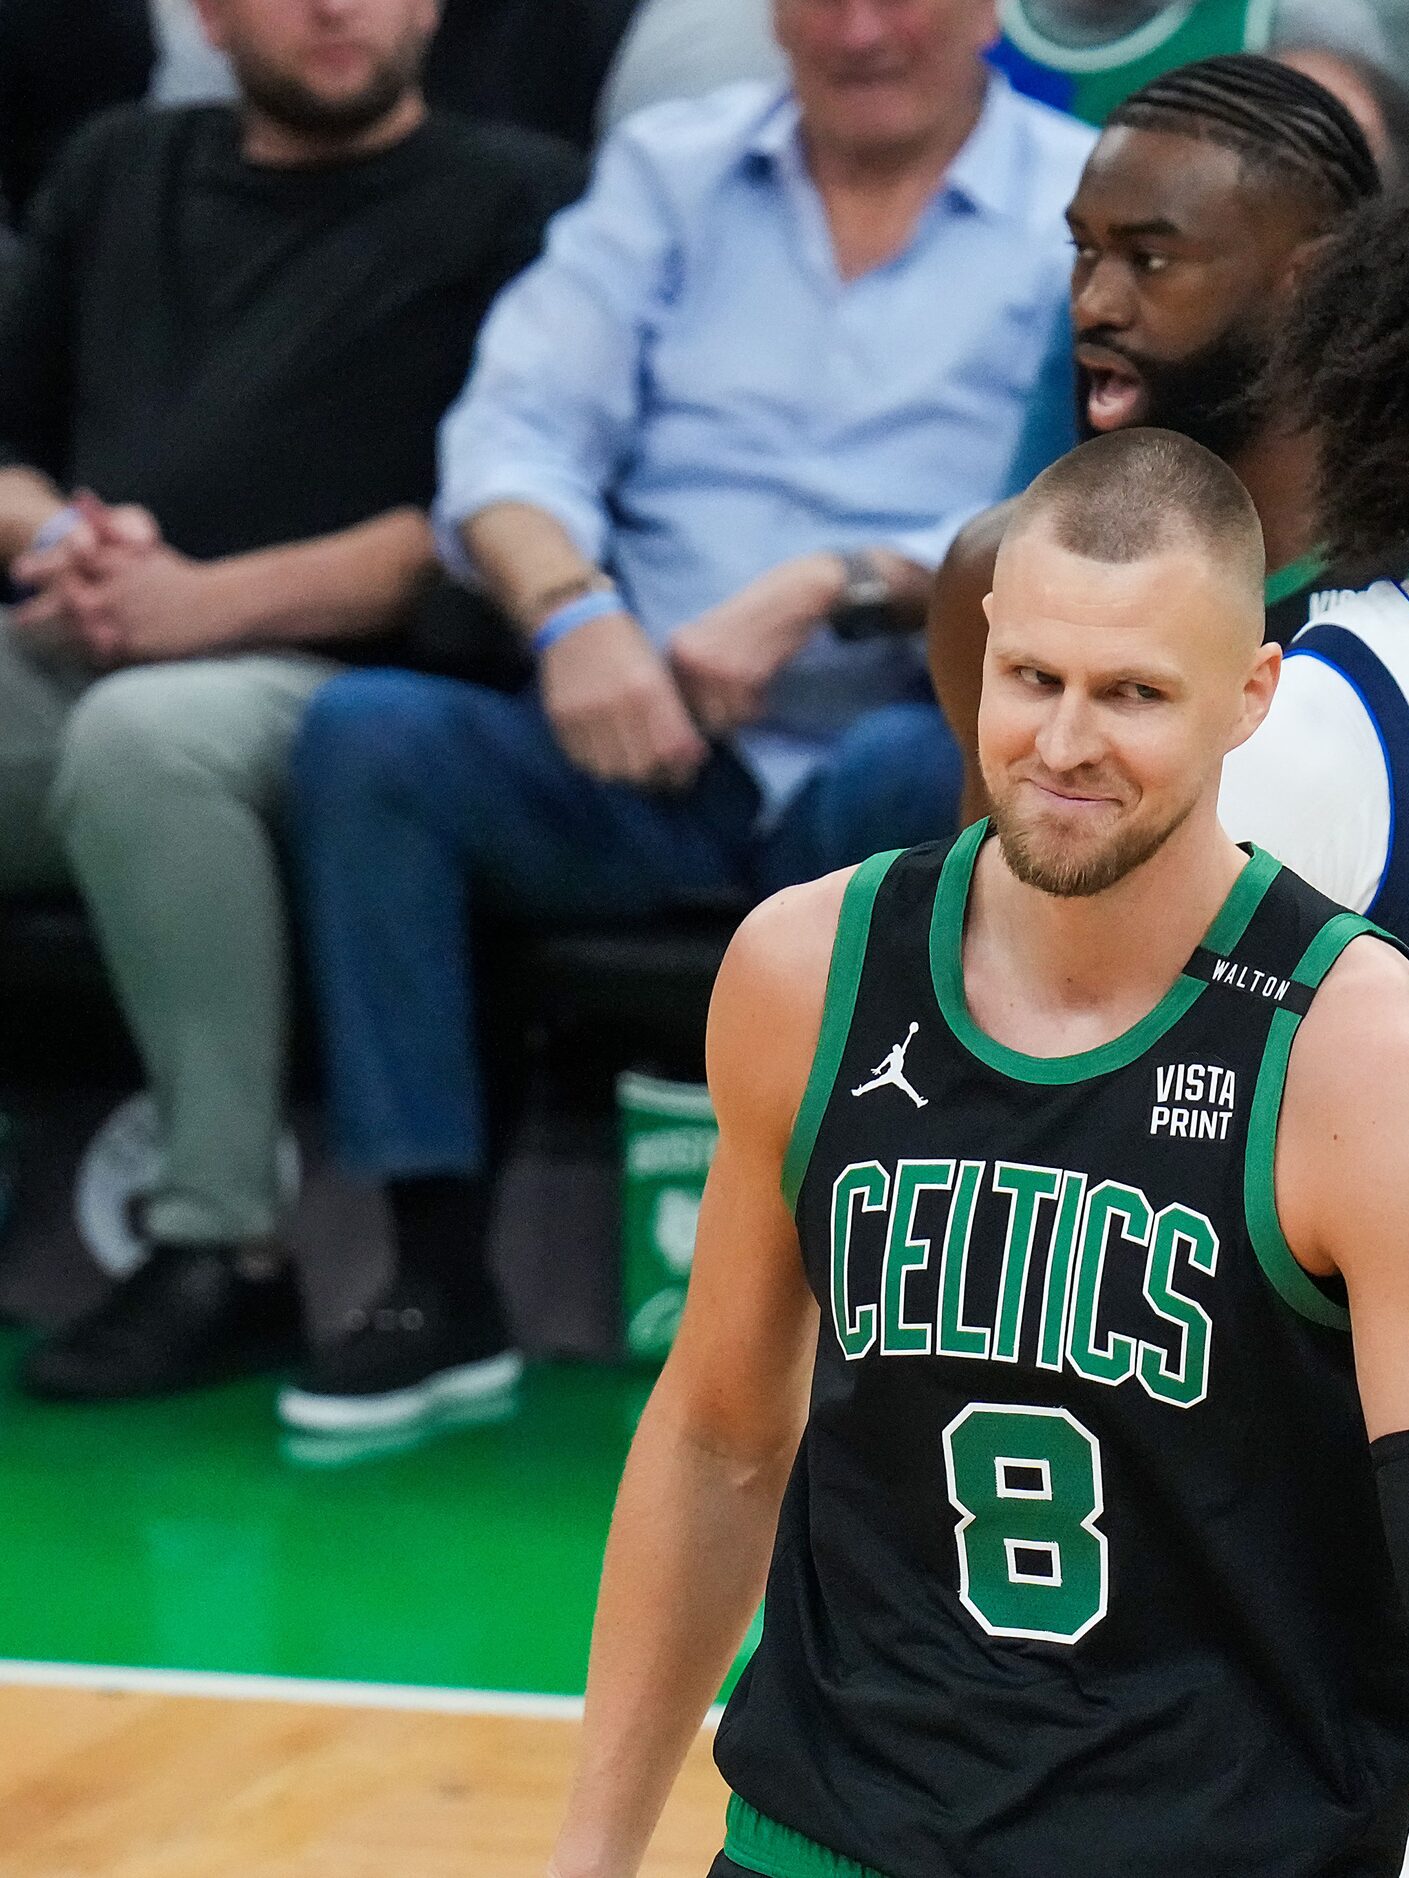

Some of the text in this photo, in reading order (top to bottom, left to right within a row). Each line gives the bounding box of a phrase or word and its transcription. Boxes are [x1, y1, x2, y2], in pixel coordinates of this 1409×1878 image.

[1211, 958, 1291, 1001] WALTON
[1156, 1063, 1236, 1110] VISTA
[1150, 1105, 1233, 1140] PRINT
[830, 1158, 1220, 1409] CELTICS
[941, 1402, 1109, 1645] 8
